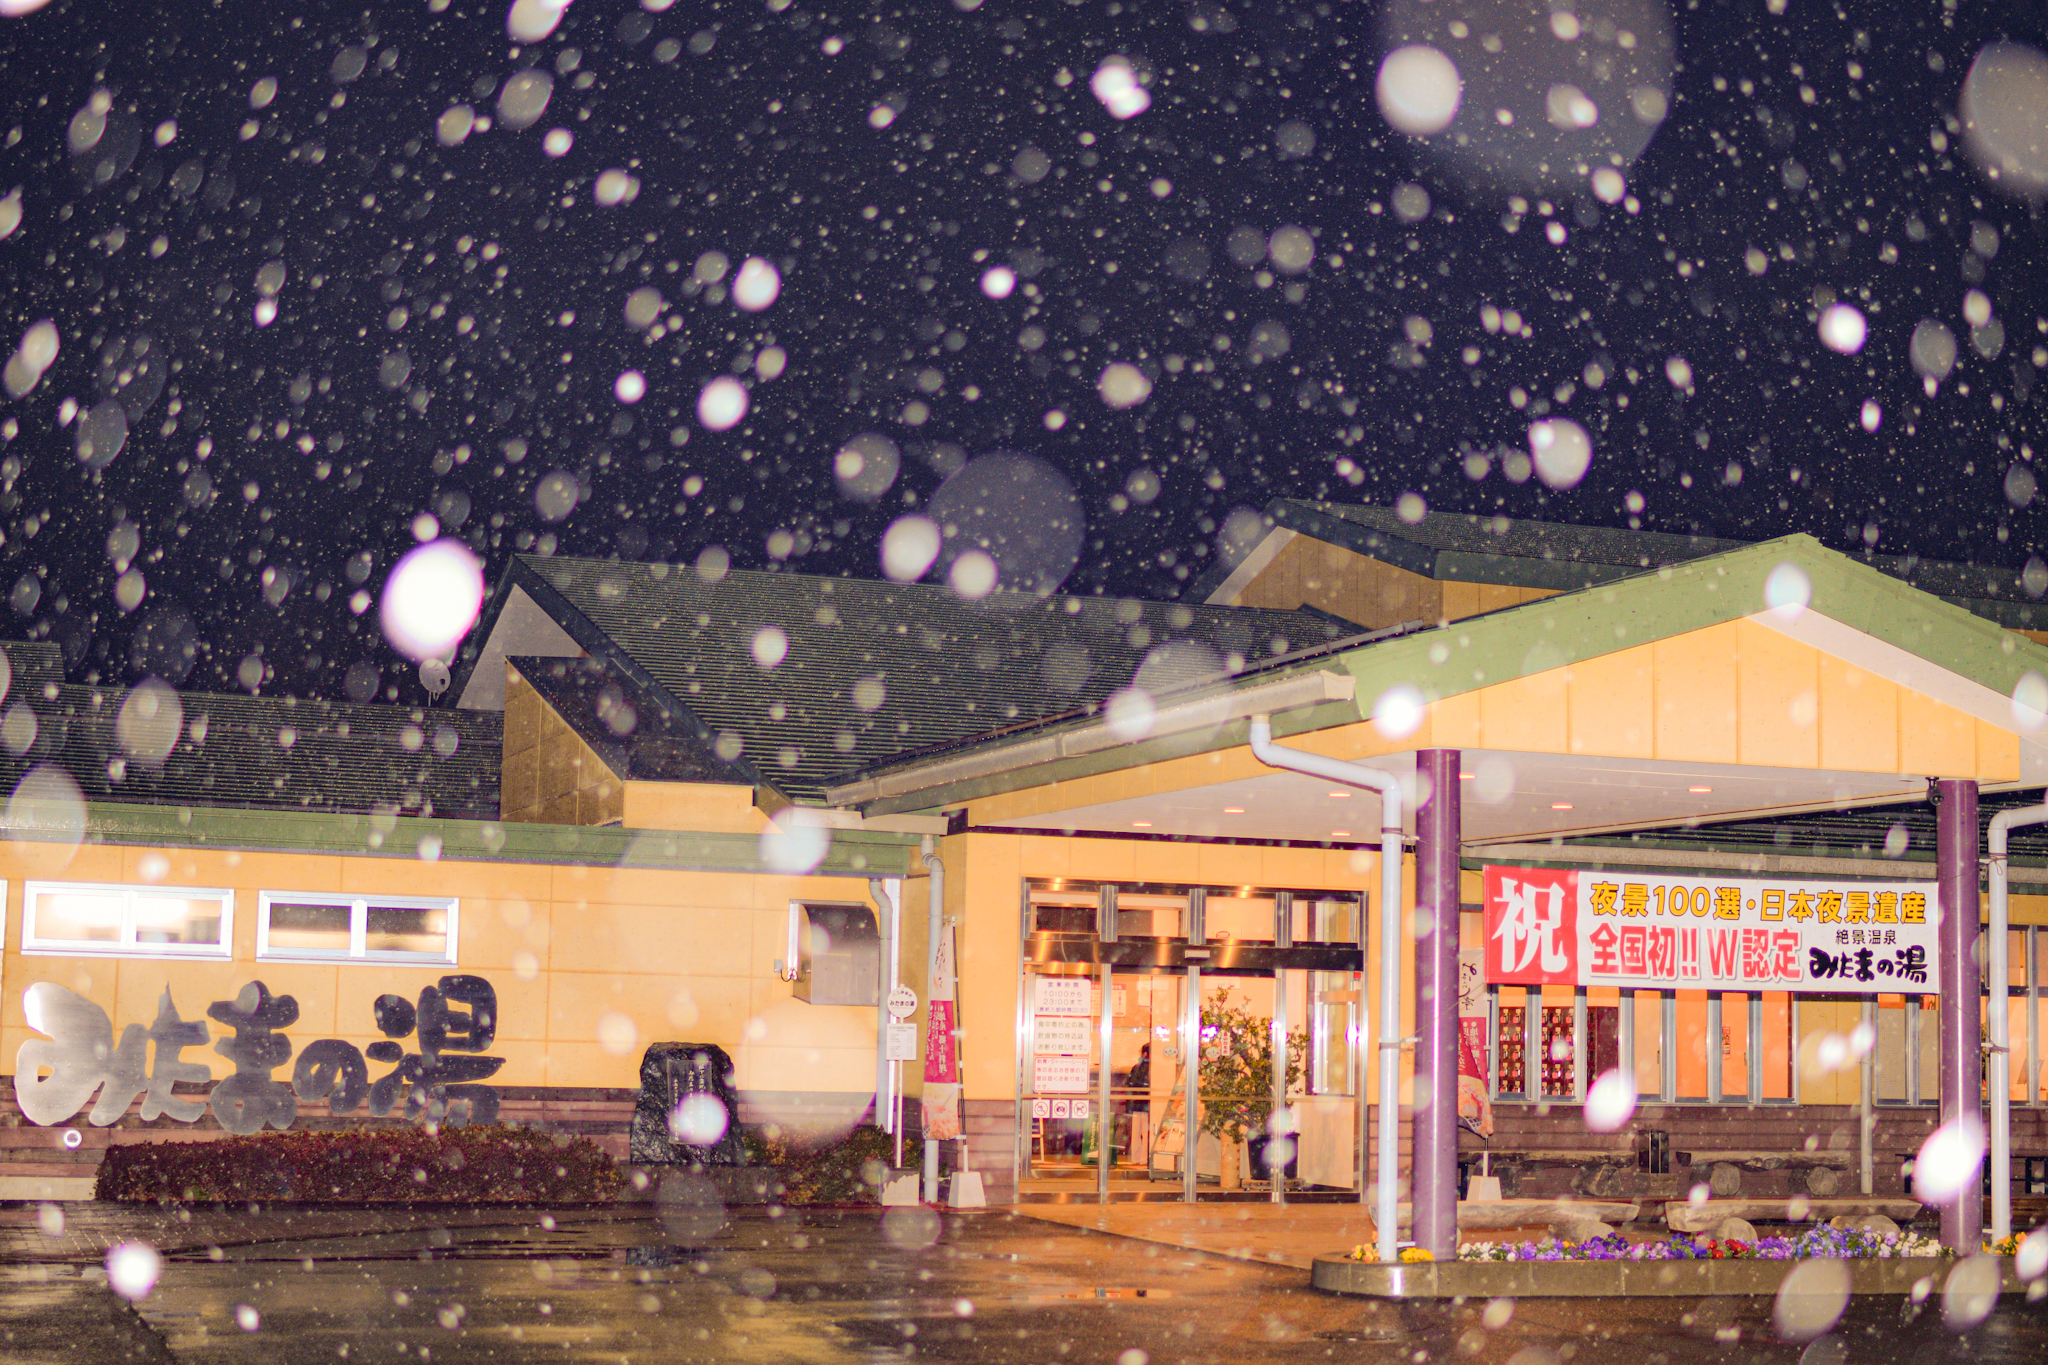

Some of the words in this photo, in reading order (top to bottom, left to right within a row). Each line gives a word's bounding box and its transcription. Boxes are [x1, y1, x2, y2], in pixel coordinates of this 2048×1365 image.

[1590, 881, 1926, 925] 夜景100選・日本夜景遺産
[1491, 876, 1568, 973] 祝
[1835, 929, 1897, 945] 絶景温泉
[1809, 945, 1928, 983] みたまの湯
[1043, 990, 1083, 998] 10:00から
[1043, 998, 1083, 1006] 23:00まで
[1038, 1032, 1084, 1040] 飲食物の持込は
[14, 974, 507, 1135] みたまの湯
[1038, 1043, 1087, 1051] お断り致します。
